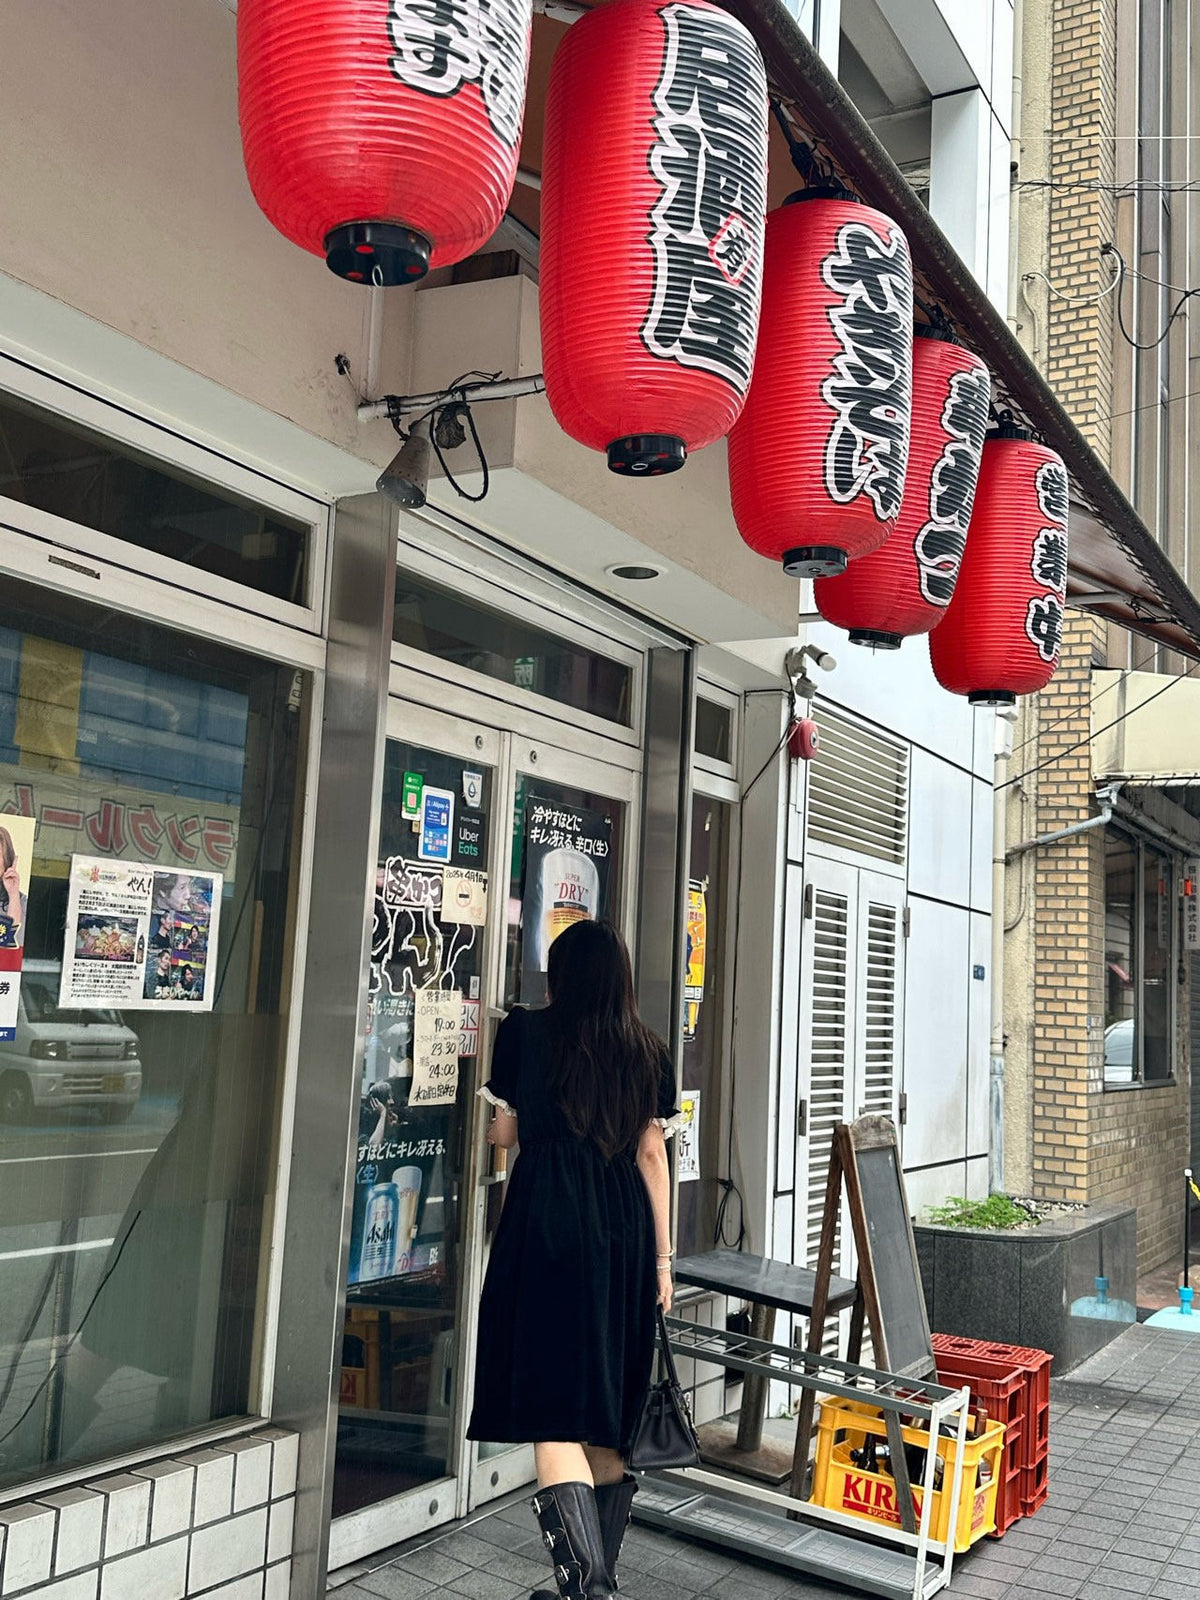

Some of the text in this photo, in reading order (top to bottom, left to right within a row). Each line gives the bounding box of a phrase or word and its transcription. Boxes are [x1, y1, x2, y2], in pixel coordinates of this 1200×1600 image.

[640, 2, 767, 396] 居酒屋
[531, 805, 583, 832] 冷やすほどに
[459, 827, 479, 842] Uber
[458, 841, 479, 857] Eats
